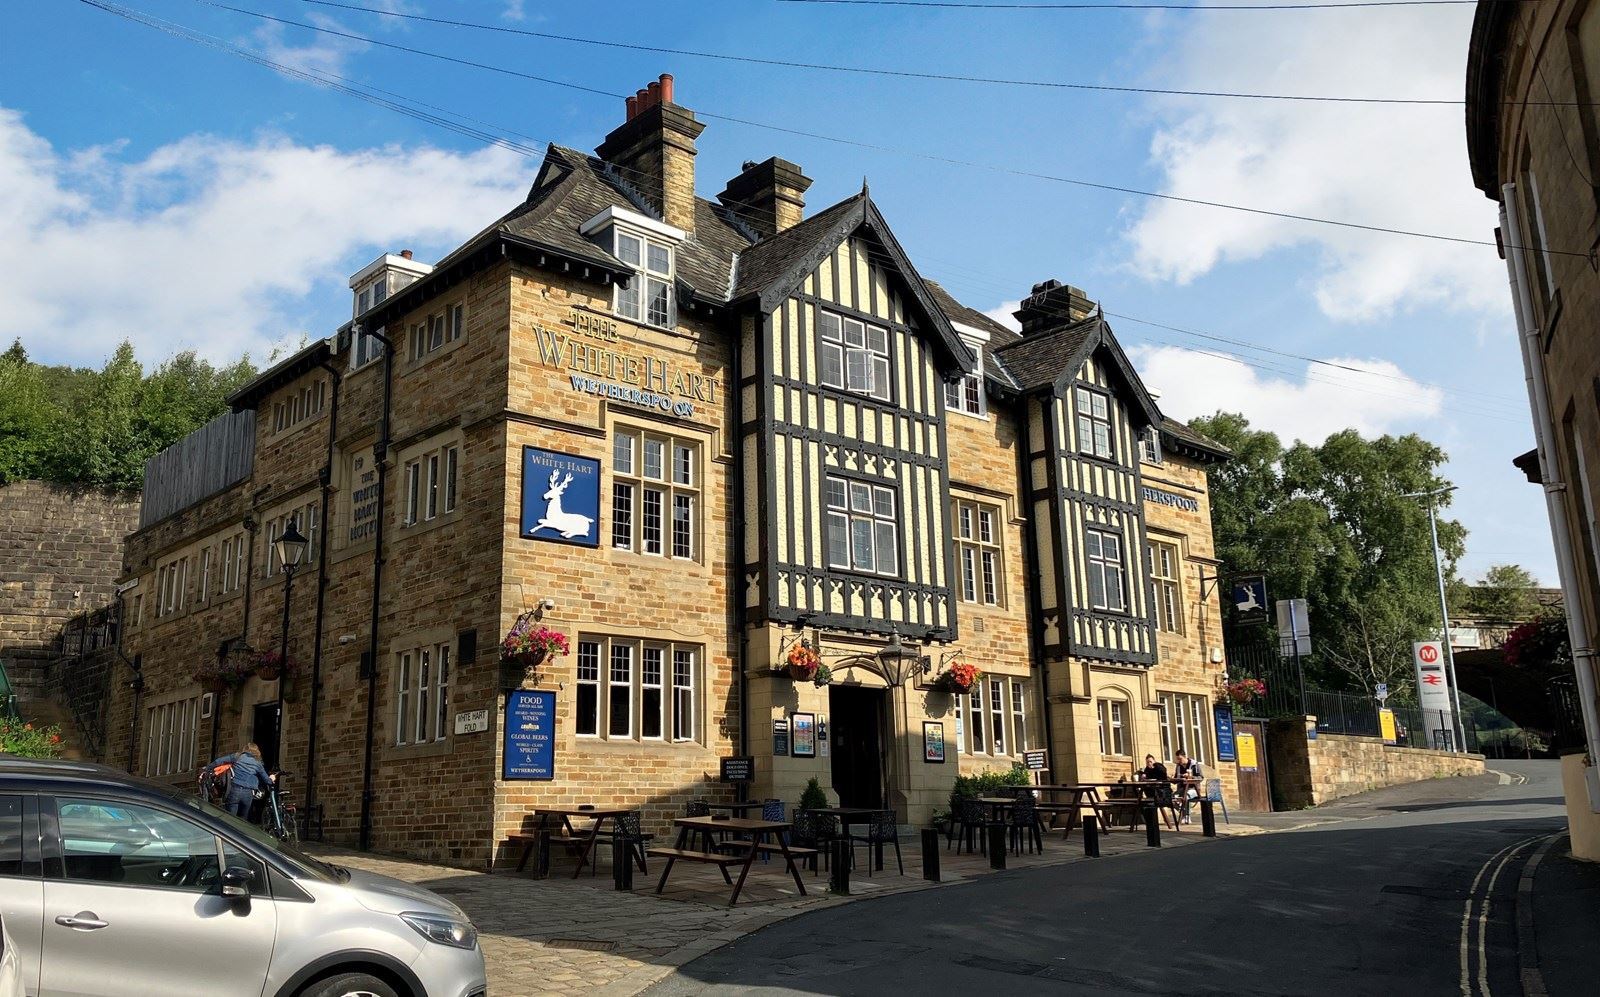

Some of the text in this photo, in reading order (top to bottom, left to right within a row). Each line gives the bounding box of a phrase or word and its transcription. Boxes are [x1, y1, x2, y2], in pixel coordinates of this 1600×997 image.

[568, 310, 620, 343] THE
[532, 323, 720, 404] WHITE HART
[570, 374, 696, 418] WETHERSPOON
[531, 455, 593, 474] WHITE HART
[1421, 649, 1436, 660] M
[520, 696, 542, 704] FOOD
[458, 711, 486, 722] WHITE HART
[464, 723, 477, 732] FOLD
